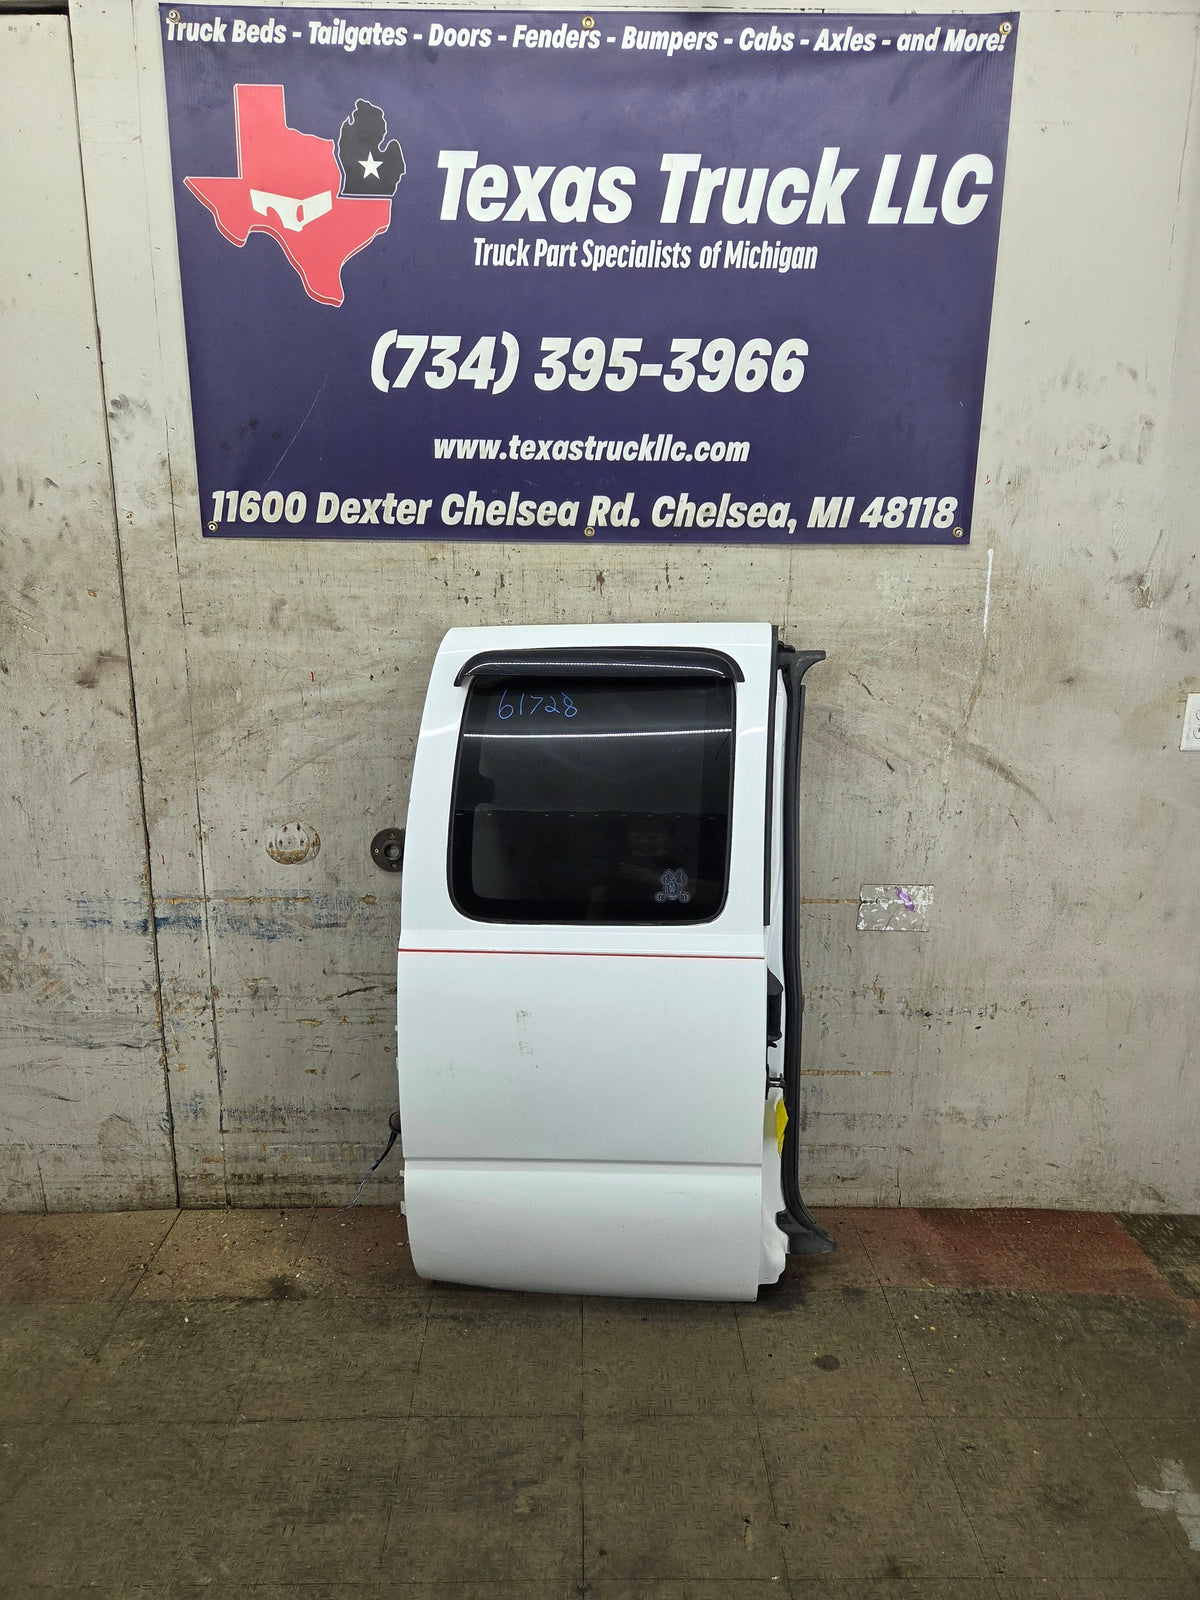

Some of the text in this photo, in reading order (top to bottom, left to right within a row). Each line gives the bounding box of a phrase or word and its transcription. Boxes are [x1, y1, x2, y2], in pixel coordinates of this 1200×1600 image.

[166, 17, 227, 42] Truck
[232, 18, 287, 43] Beds
[308, 19, 408, 52] Tailgates
[427, 23, 492, 47] Doors
[512, 23, 601, 49] Fenders
[621, 26, 718, 56] Bumpers
[738, 26, 795, 51] Cabs
[813, 26, 876, 51] Axles
[897, 27, 941, 51] and
[943, 29, 1008, 52] More!
[437, 147, 993, 225] Texas Truck LLC
[474, 238, 818, 273] Truck Part Specialists of Michigan
[371, 329, 808, 394] (734) 395-3966
[434, 434, 750, 463] www.texastruckllc.com
[212, 490, 958, 533] 11600 Dexter Chelsea Rd. Chelsea, MI 48118
[498, 689, 578, 719] 61728
